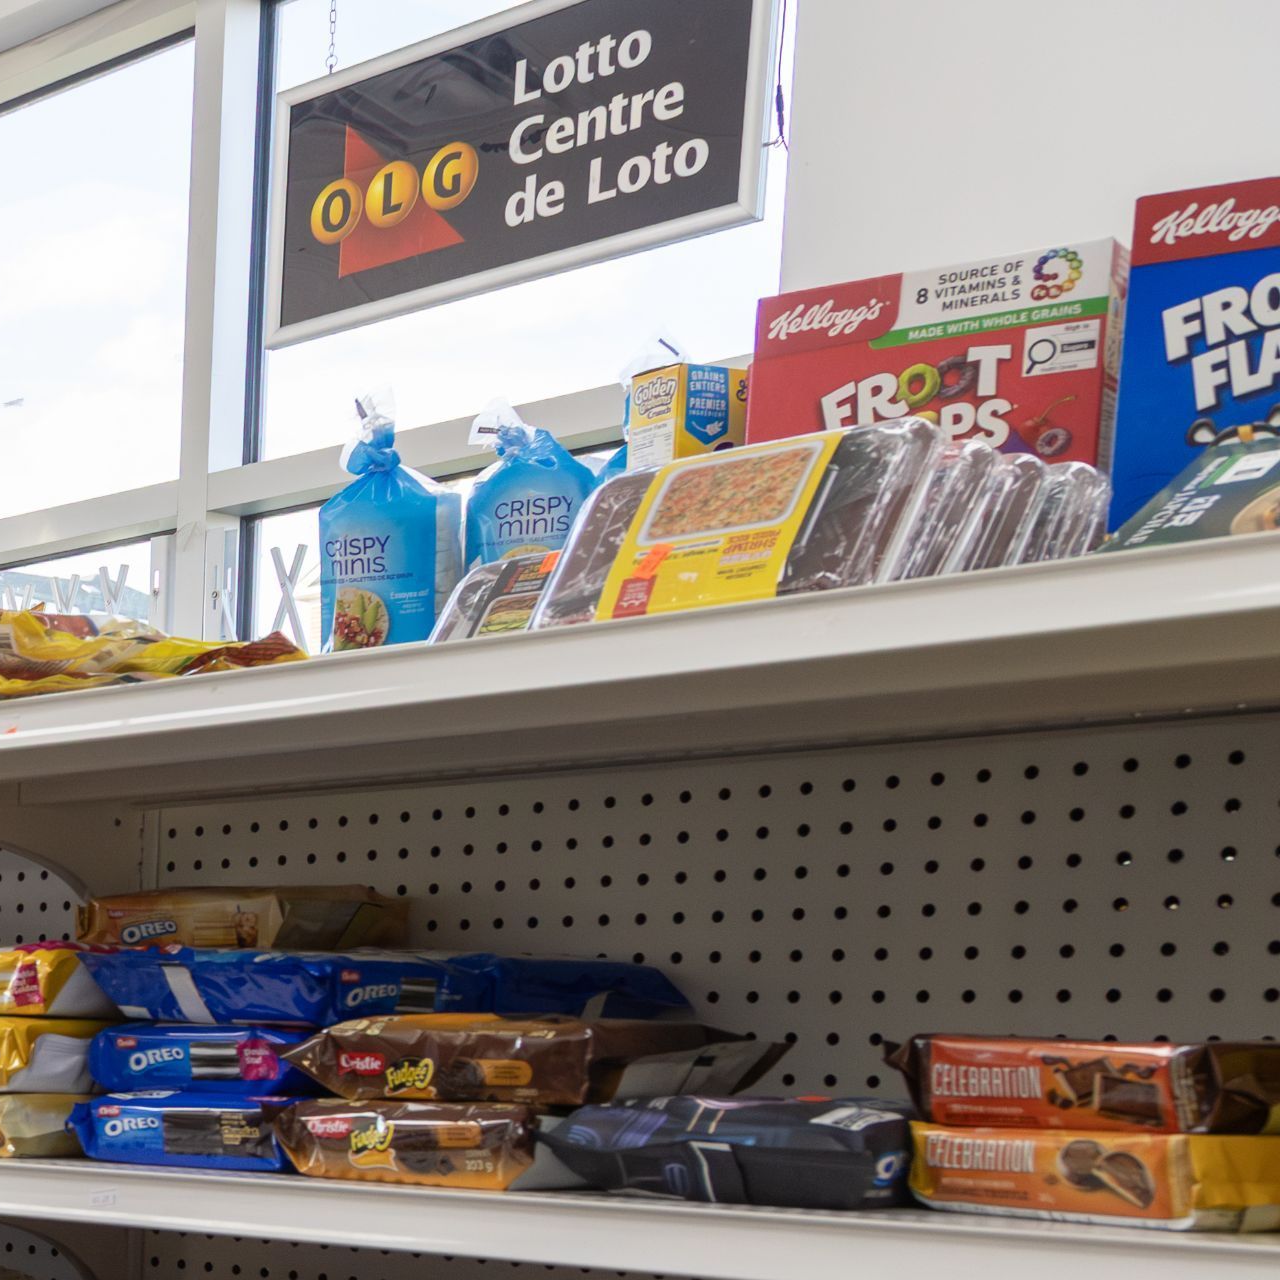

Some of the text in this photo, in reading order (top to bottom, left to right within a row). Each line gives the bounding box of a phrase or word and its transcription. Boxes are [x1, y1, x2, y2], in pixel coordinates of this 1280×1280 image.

[514, 30, 652, 104] Lotto
[509, 82, 685, 166] Centre
[504, 138, 709, 228] de Loto
[938, 260, 1023, 286] SOURCE OF
[916, 274, 1022, 305] 8 VITAMINS &
[941, 288, 1021, 311] MINERALS
[767, 296, 885, 341] Kellogg's
[908, 302, 1082, 341] MADE WITH WHOLE GRAINS
[690, 382, 725, 393] ENTIERS
[691, 370, 725, 383] GRAINS
[820, 344, 1013, 430] FROOT
[634, 378, 676, 405] Golden
[689, 398, 725, 410] PREMIER
[495, 495, 573, 519] CRISPY
[498, 515, 570, 539] minis
[325, 535, 390, 558] CRISPY
[119, 919, 178, 944] OREO
[345, 984, 397, 1007] OREO
[128, 1046, 184, 1071] OREO
[104, 1115, 159, 1136] OREO
[308, 1119, 352, 1135] Christie
